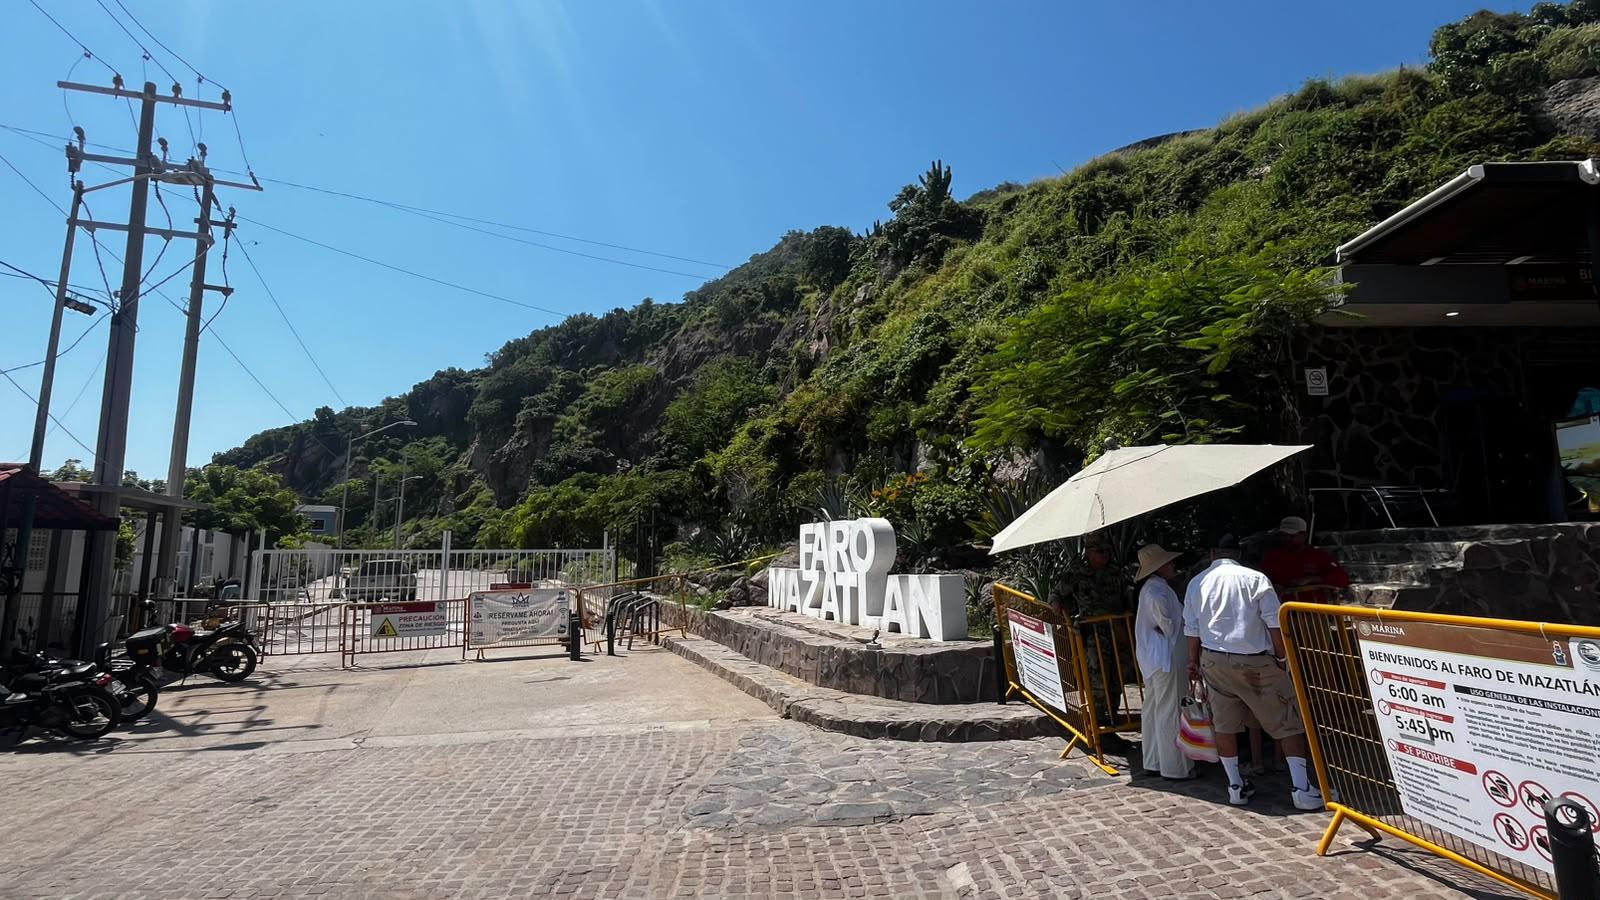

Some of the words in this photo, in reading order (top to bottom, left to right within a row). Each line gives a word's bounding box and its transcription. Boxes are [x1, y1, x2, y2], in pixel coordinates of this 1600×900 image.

[800, 518, 878, 573] FARO
[768, 567, 947, 641] MAZATLAN
[1371, 624, 1405, 636] MARINA
[1369, 650, 1438, 671] BIENVENIDOS
[1441, 662, 1456, 674] AL
[1458, 664, 1492, 680] FARO
[1496, 670, 1514, 683] DE
[1388, 684, 1418, 702] 6:00
[1422, 694, 1446, 708] am
[1469, 688, 1485, 697] USO
[1484, 691, 1517, 703] GENERAL
[1517, 696, 1528, 705] DE
[1528, 698, 1543, 708] LAS
[1396, 716, 1426, 734] 5:45
[1430, 726, 1454, 743] pm
[1404, 744, 1415, 756] SE
[1416, 748, 1456, 768] PROHIBE
